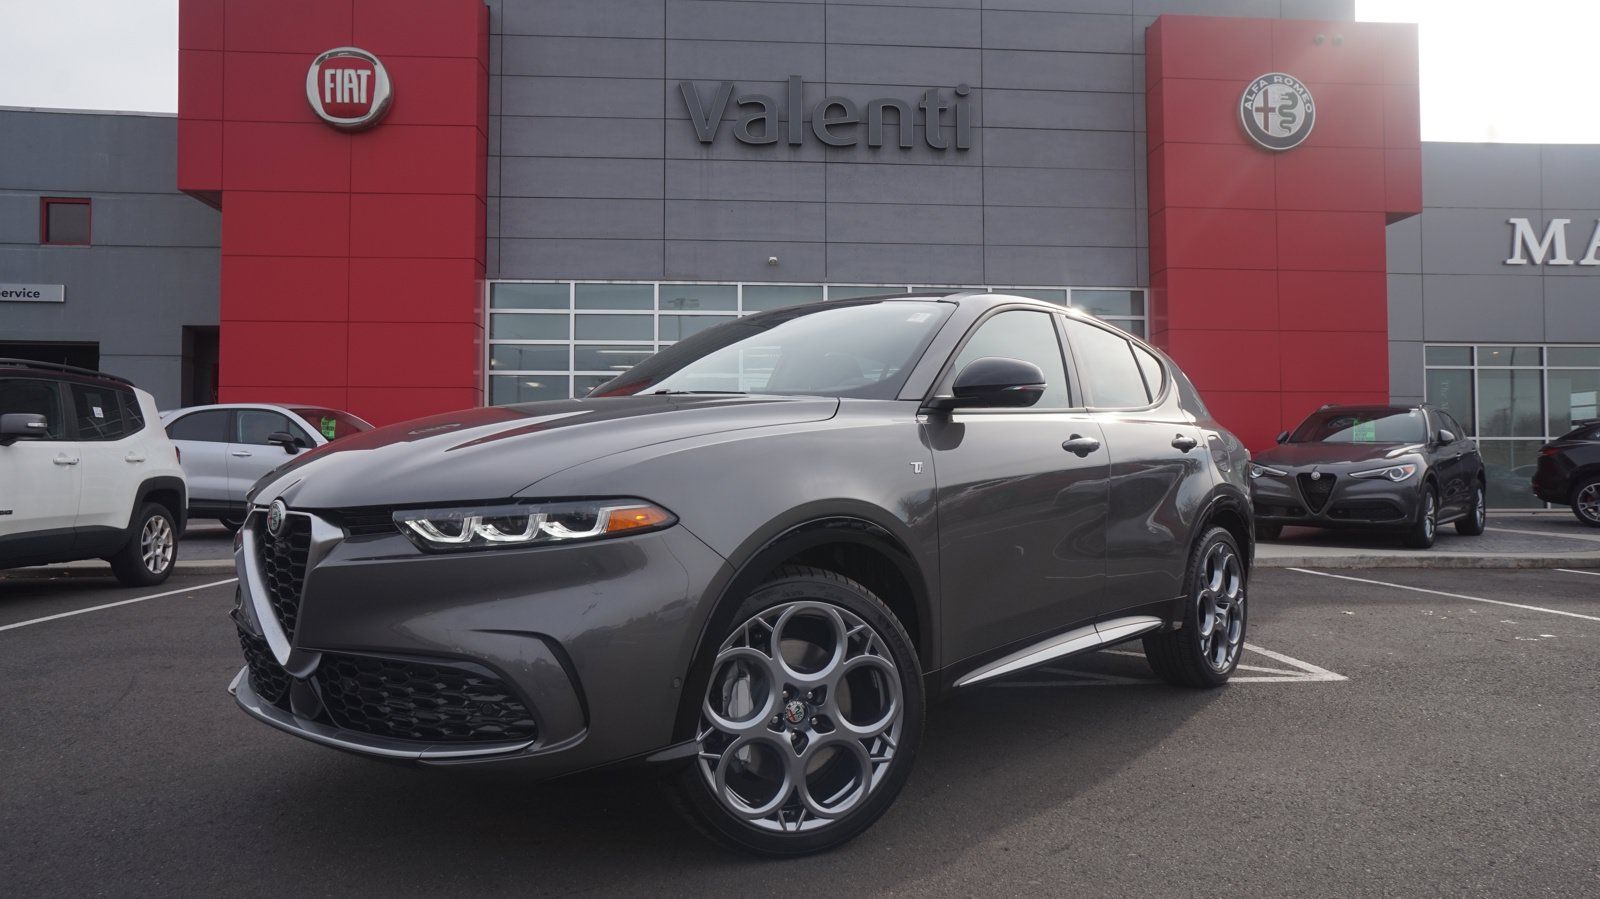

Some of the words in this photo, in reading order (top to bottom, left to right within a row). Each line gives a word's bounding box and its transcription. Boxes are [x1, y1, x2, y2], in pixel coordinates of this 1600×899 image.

[324, 68, 371, 104] FIAT
[1244, 79, 1269, 111] ALFA
[1273, 75, 1314, 114] ROMEO
[678, 75, 971, 150] Valenti
[0, 287, 41, 299] ervice
